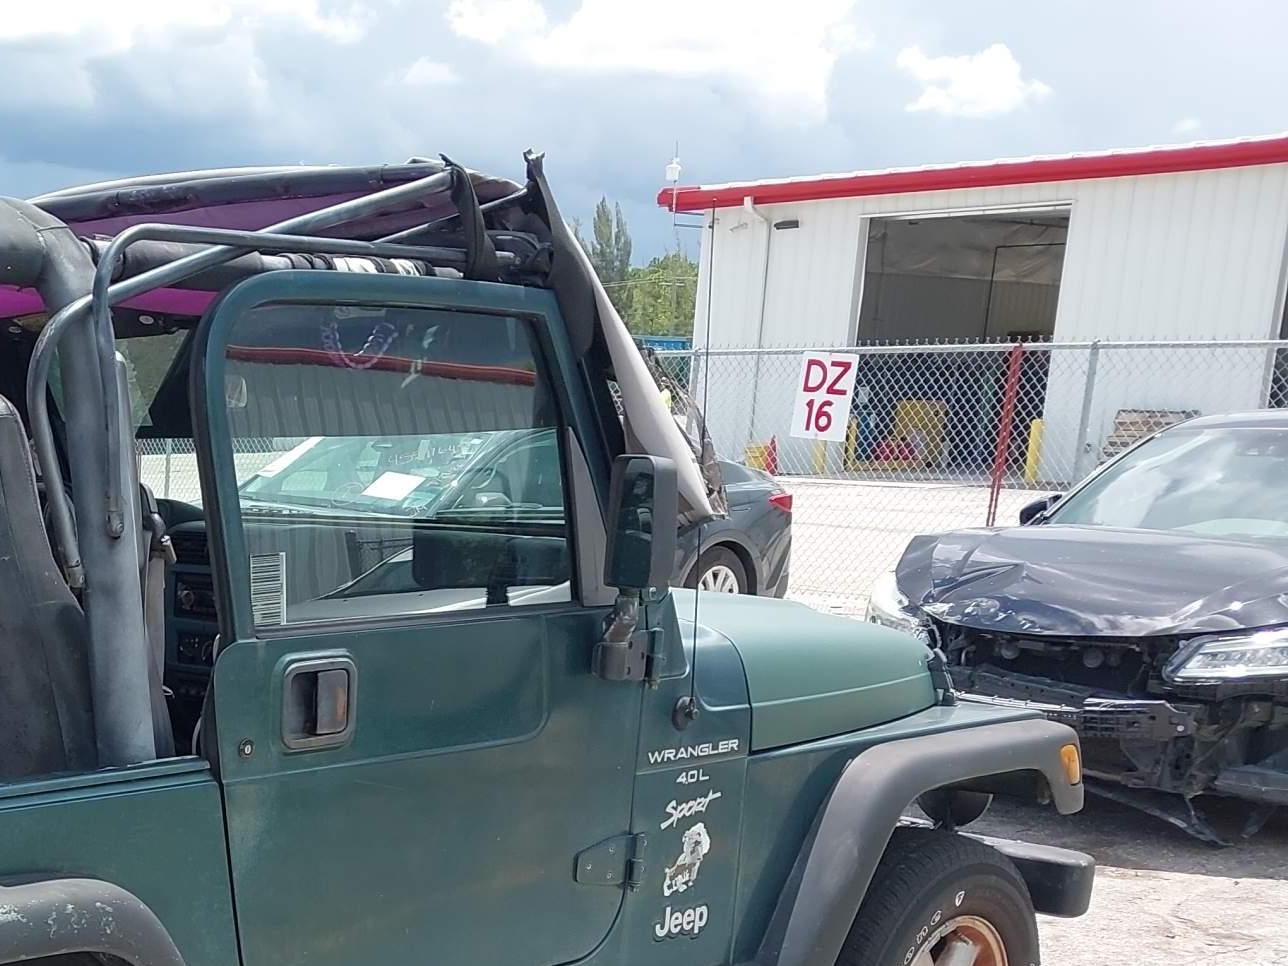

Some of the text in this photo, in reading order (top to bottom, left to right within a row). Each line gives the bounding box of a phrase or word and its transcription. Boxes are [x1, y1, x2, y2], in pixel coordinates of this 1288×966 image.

[803, 358, 852, 395] DZ
[805, 398, 834, 432] 16
[648, 739, 739, 764] WRANGLER
[655, 905, 709, 937] Jeep
